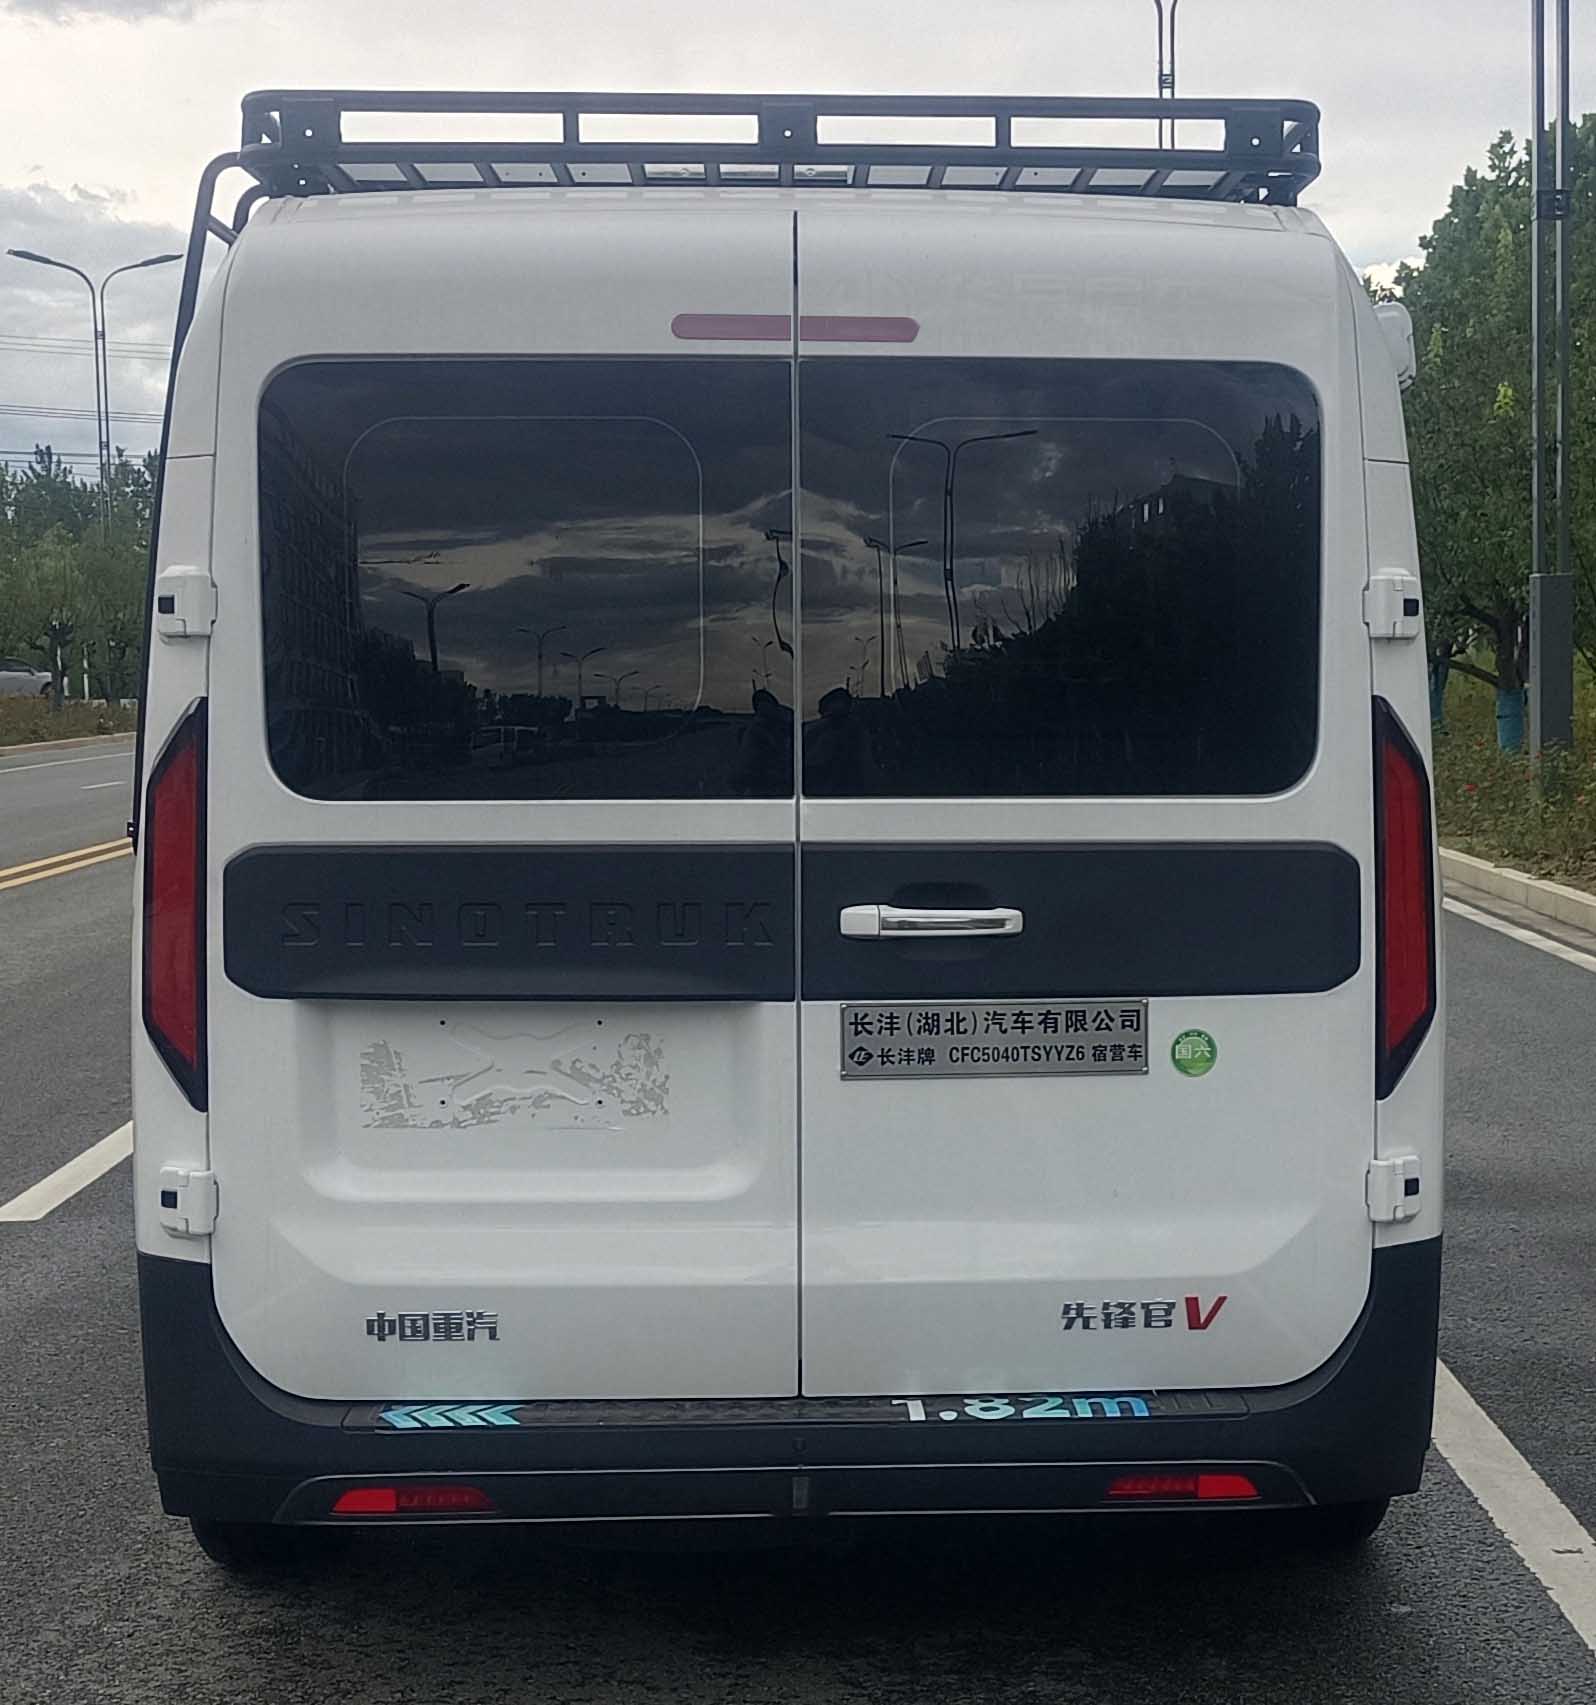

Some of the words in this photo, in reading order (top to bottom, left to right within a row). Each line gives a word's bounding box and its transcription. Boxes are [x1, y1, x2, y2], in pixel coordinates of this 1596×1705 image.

[281, 902, 775, 948] SINOTRUK
[877, 1047, 936, 1066] 长沣牌
[949, 1044, 1085, 1063] CFC5040TSYYZ6
[1091, 1043, 1143, 1062] 宿营车
[1175, 1044, 1211, 1059] 国六
[366, 1310, 500, 1341] 中国重汽
[891, 1396, 1149, 1421] 1.82m
